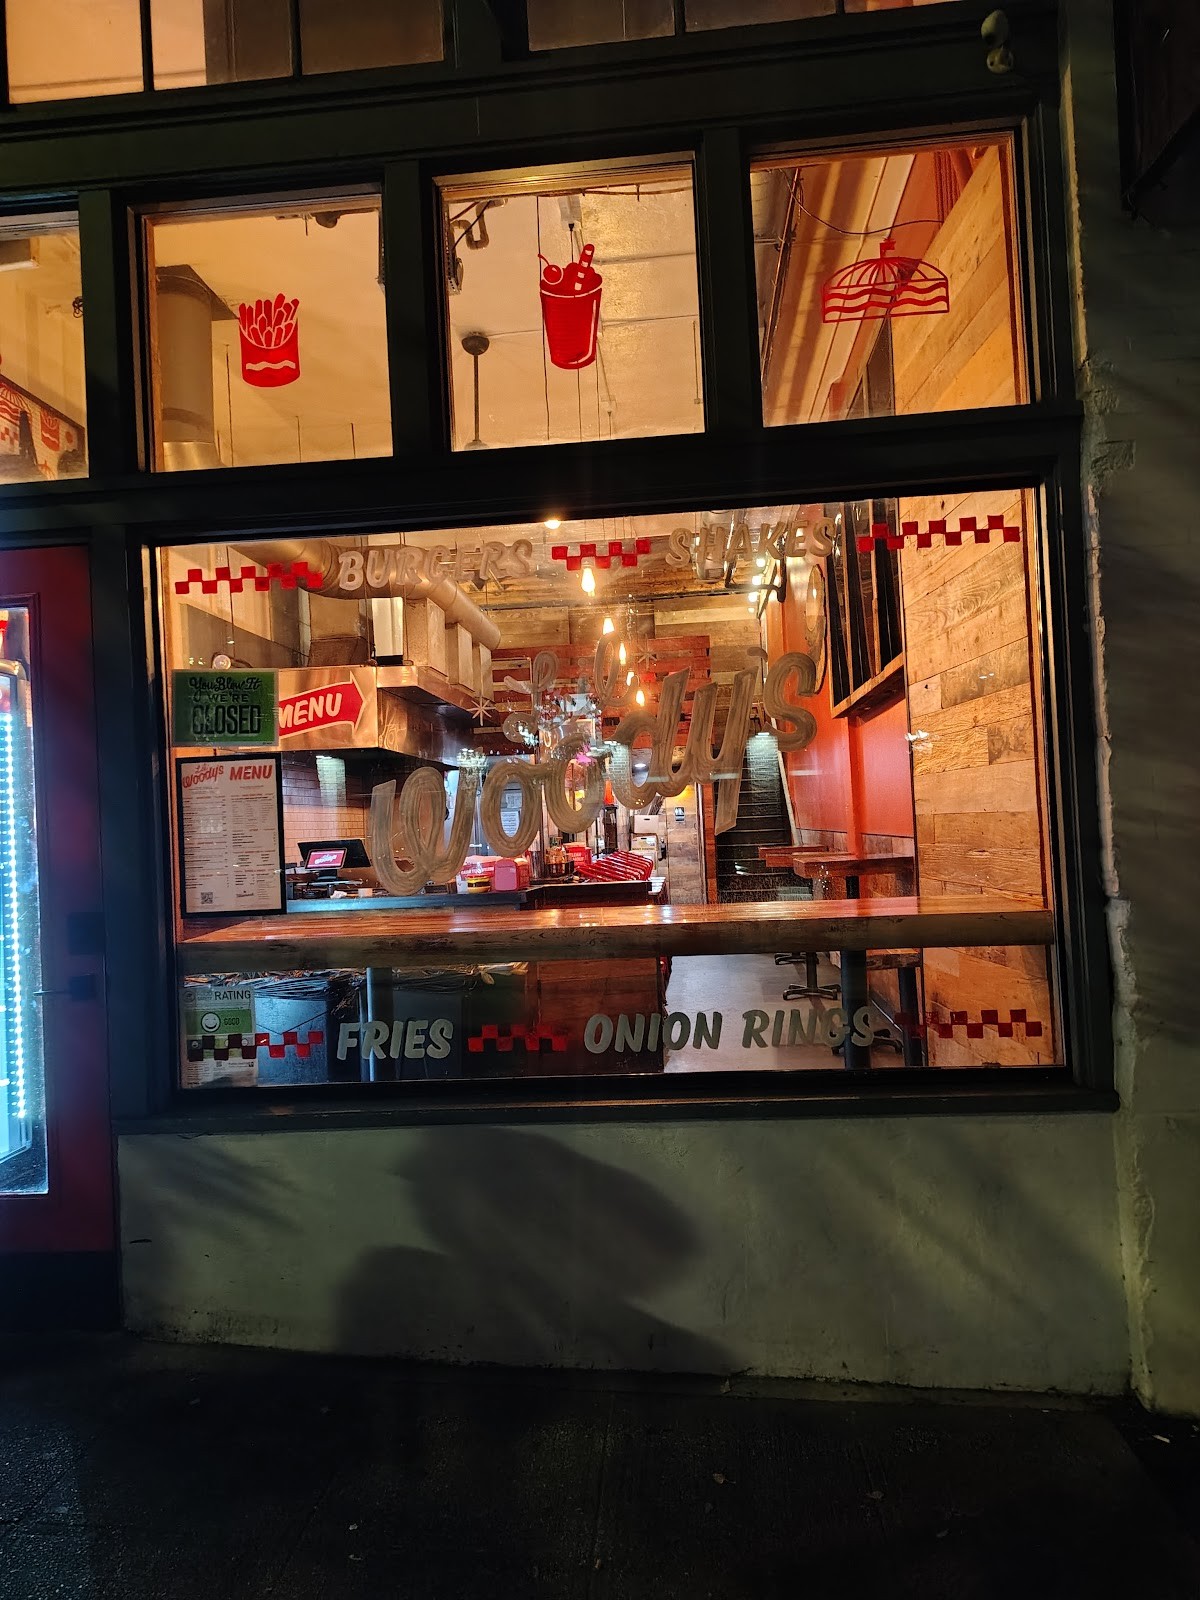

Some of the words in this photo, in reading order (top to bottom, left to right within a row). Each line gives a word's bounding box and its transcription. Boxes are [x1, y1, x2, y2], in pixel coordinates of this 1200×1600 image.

[664, 517, 836, 567] SHAKES
[338, 539, 533, 591] BURGERS
[208, 692, 249, 702] WE'RE
[279, 692, 343, 729] MENU
[192, 704, 262, 735] CLOSED
[182, 765, 224, 789] Woody's
[229, 765, 273, 781] MENU
[214, 989, 252, 1001] RATING
[336, 1018, 455, 1061] FRIES
[583, 1010, 723, 1054] ONION
[741, 1005, 876, 1049] RINGS
